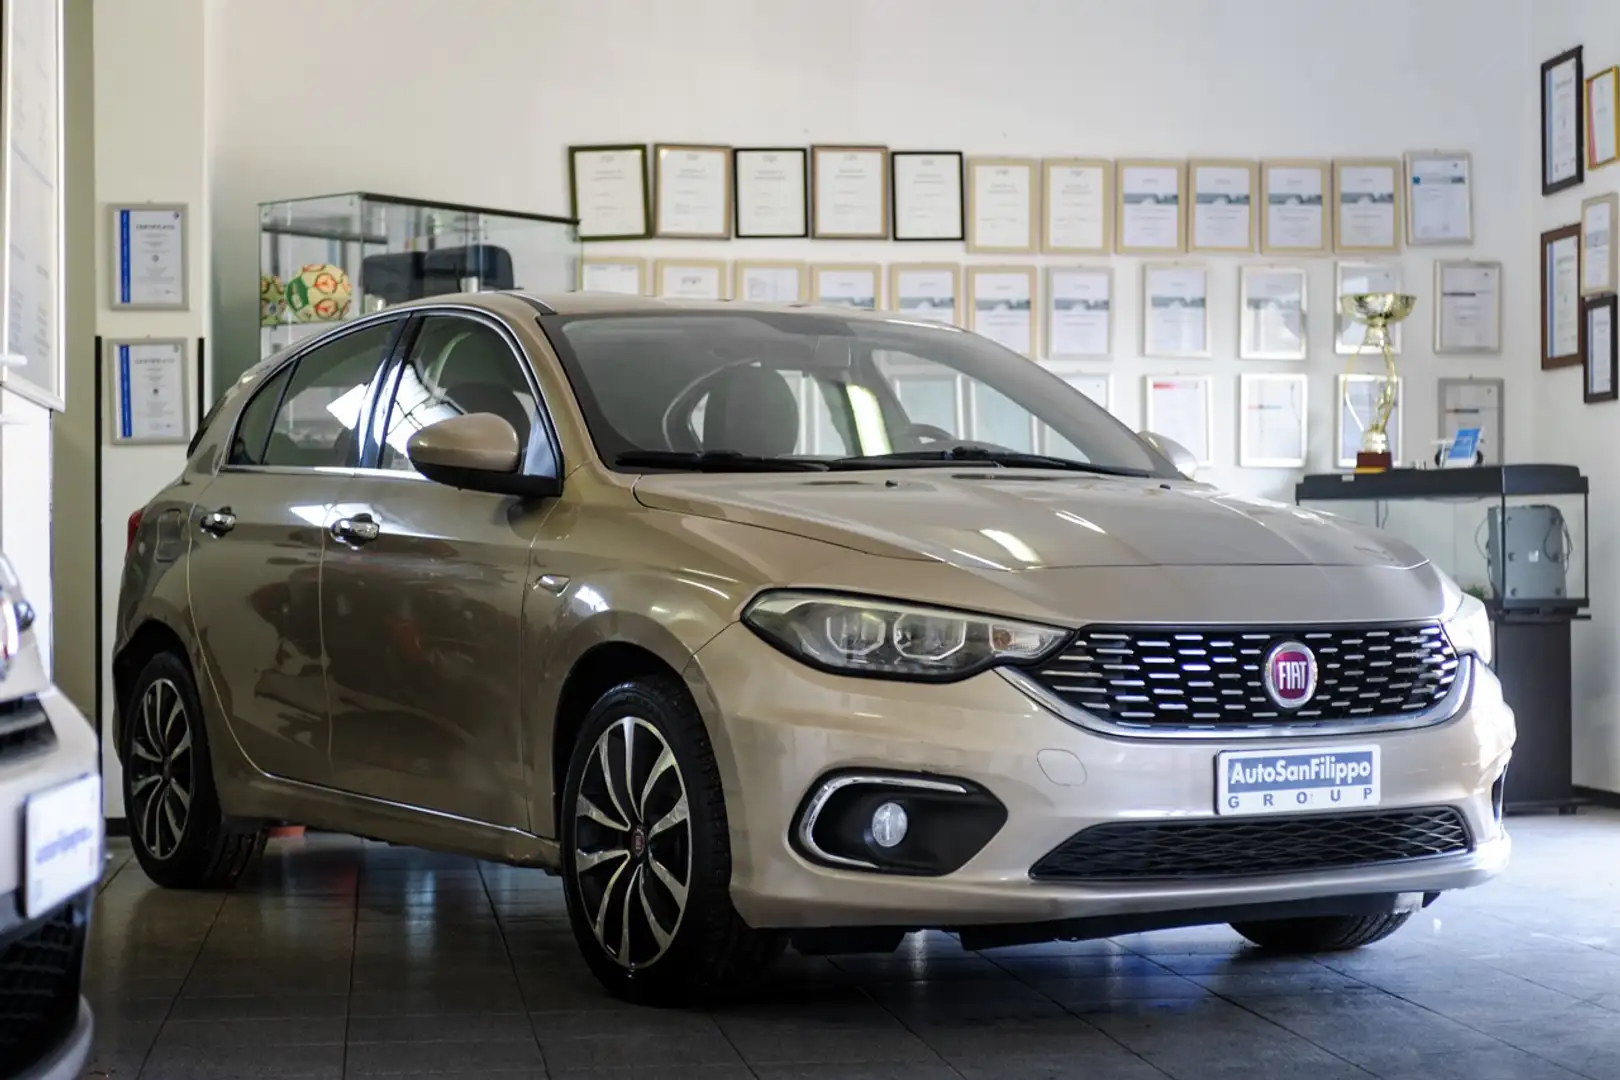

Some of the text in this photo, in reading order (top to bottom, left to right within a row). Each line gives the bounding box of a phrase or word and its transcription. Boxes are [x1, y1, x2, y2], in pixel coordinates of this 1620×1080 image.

[1278, 660, 1307, 690] FIAT
[1230, 756, 1371, 784] AutoSanFilippo
[1228, 787, 1372, 808] GROUP
